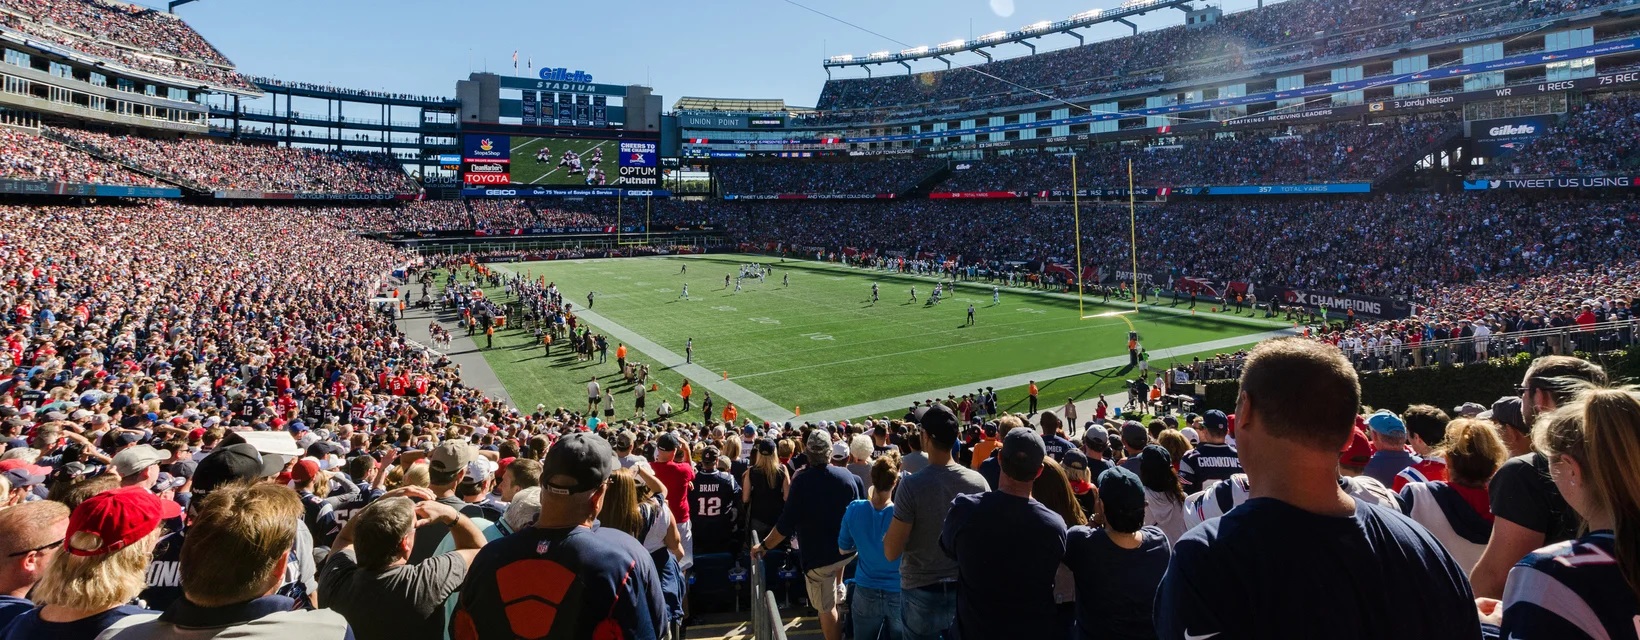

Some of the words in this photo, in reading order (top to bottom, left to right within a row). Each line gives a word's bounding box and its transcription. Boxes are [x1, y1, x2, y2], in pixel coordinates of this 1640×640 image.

[539, 67, 592, 83] Gillette
[1598, 76, 1612, 85] 75
[1615, 72, 1638, 83] REC
[536, 82, 596, 92] STADIUM
[1548, 81, 1574, 90] RECS
[1496, 88, 1511, 96] WR
[1403, 99, 1424, 107] Jordy
[1426, 96, 1454, 105] Nelson
[1229, 117, 1265, 125] DRAFTKINGS
[1489, 125, 1535, 136] Gillette
[620, 167, 656, 175] OPTUM
[1506, 179, 1554, 188] TWEET
[1558, 179, 1579, 188] US
[1583, 177, 1629, 187] USING
[1116, 270, 1153, 282] PATROTS
[1310, 294, 1381, 314] CHAMPIONS
[243, 406, 253, 416] 12
[700, 484, 719, 492] BRADY
[698, 497, 721, 516] 12
